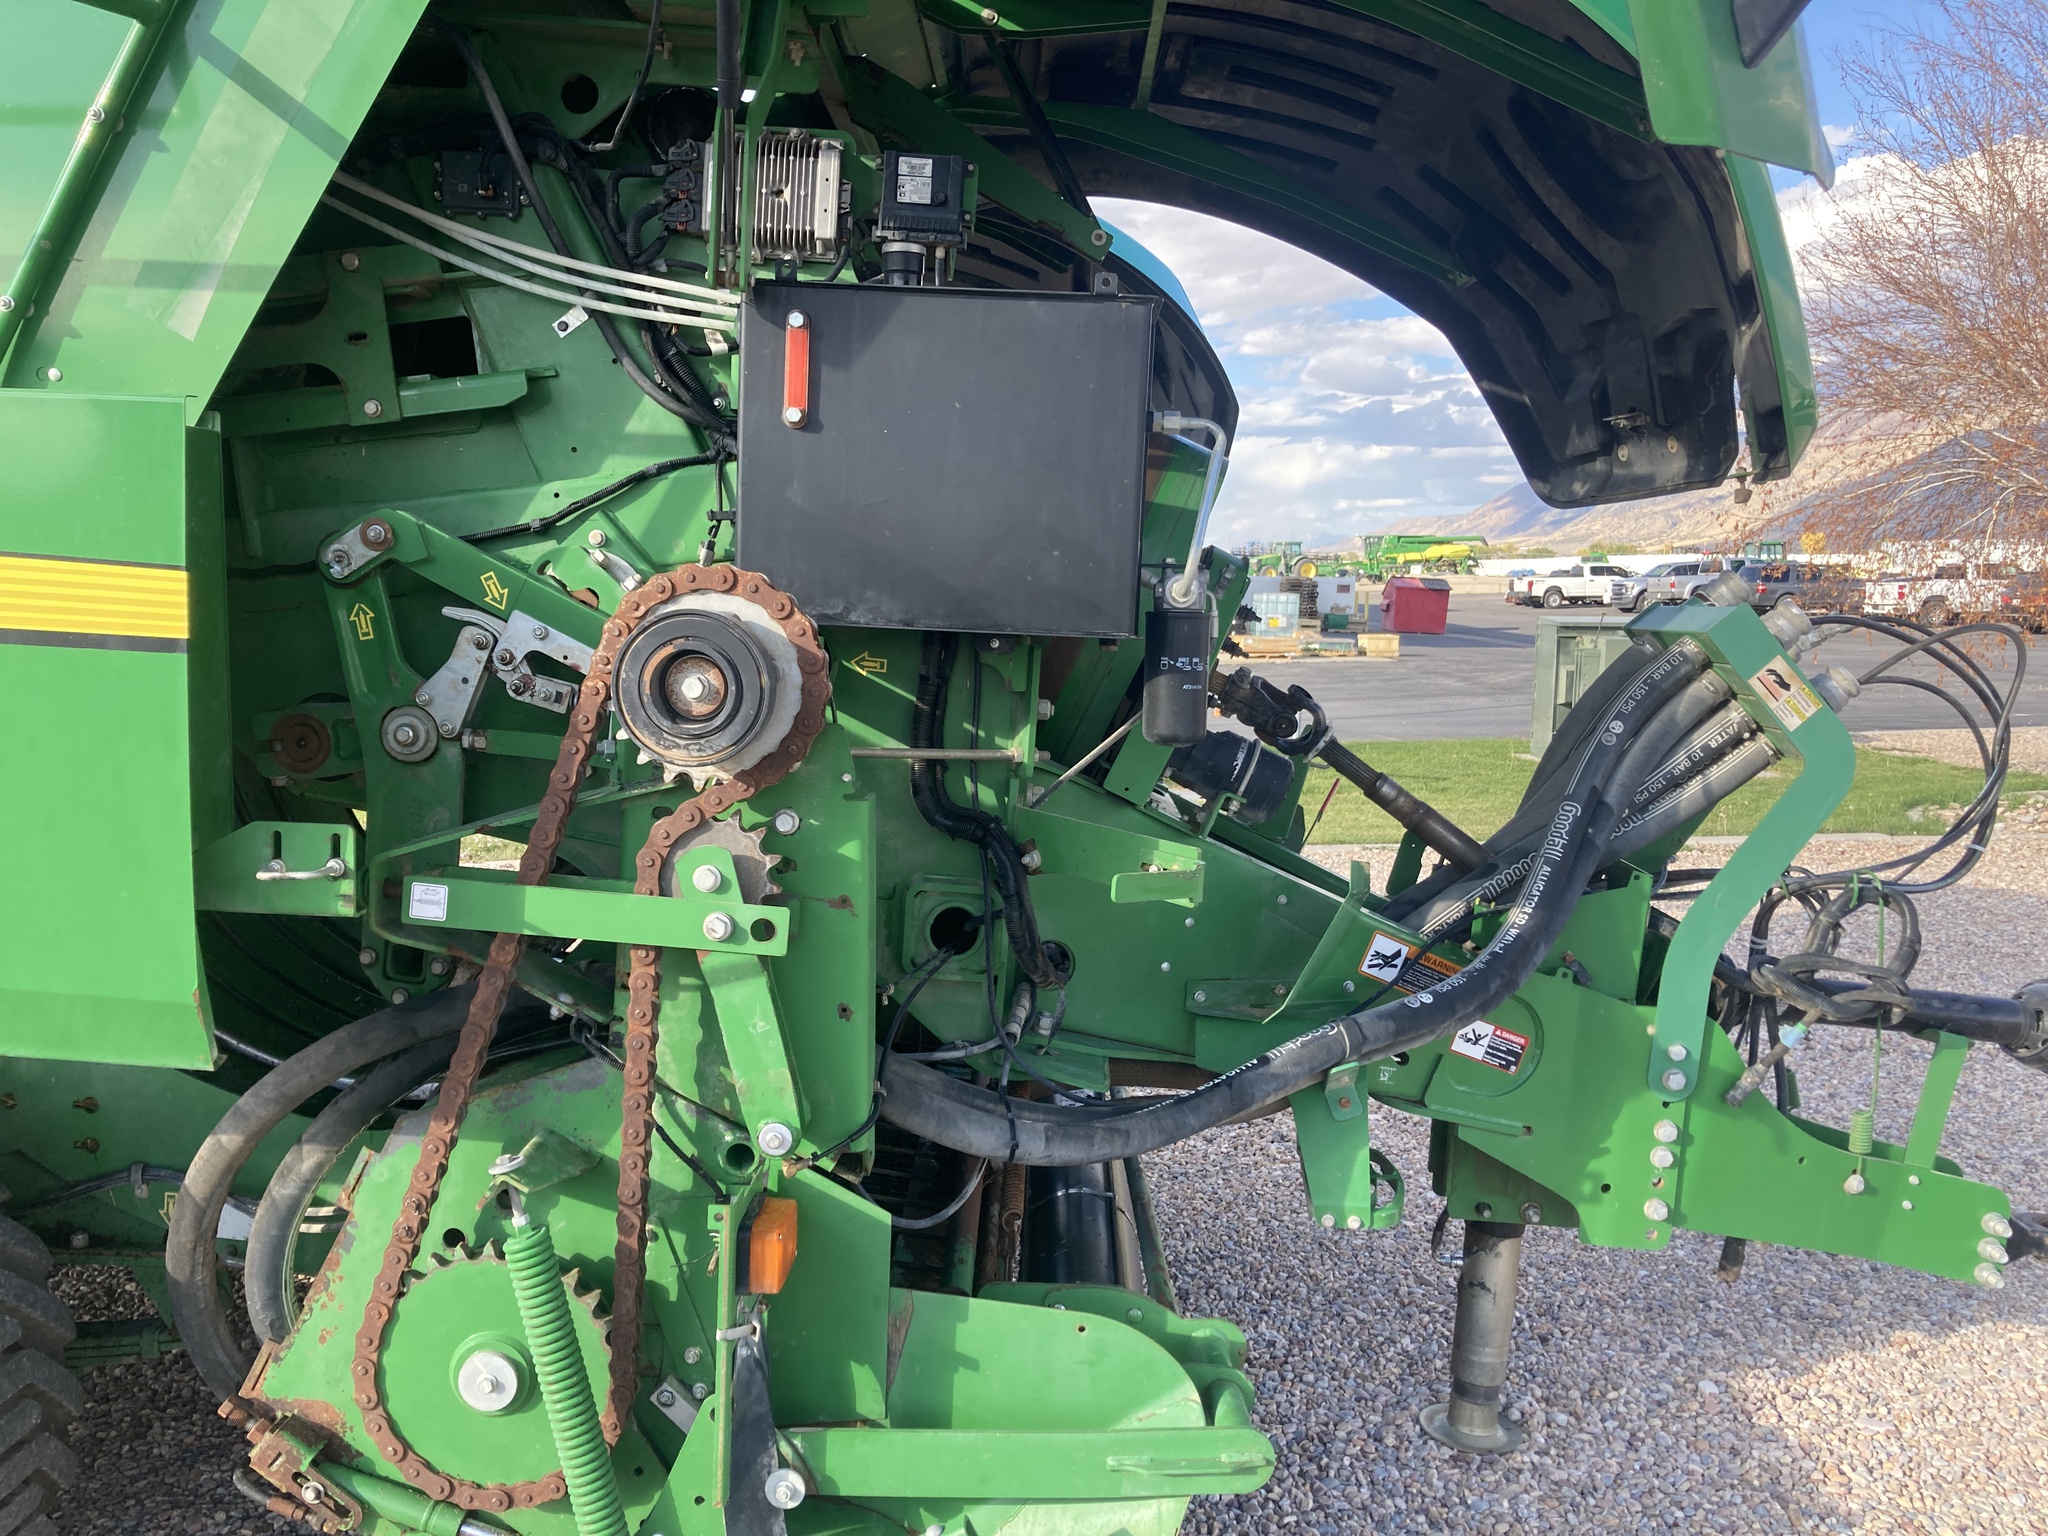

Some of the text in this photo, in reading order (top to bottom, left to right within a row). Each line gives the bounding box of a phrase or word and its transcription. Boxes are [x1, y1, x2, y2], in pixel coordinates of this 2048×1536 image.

[1669, 652, 1684, 666] 10
[1650, 662, 1672, 680] BAR
[1631, 683, 1649, 700] 150
[1620, 699, 1636, 714] PSI
[1691, 749, 1704, 762] 10
[1671, 758, 1692, 777] BAR
[1649, 776, 1667, 793] 150
[1633, 790, 1649, 804] PSI
[1540, 801, 1581, 861] Goodall
[1520, 864, 1552, 914] ALLIGATOR
[1501, 1031, 1526, 1046] DANGER
